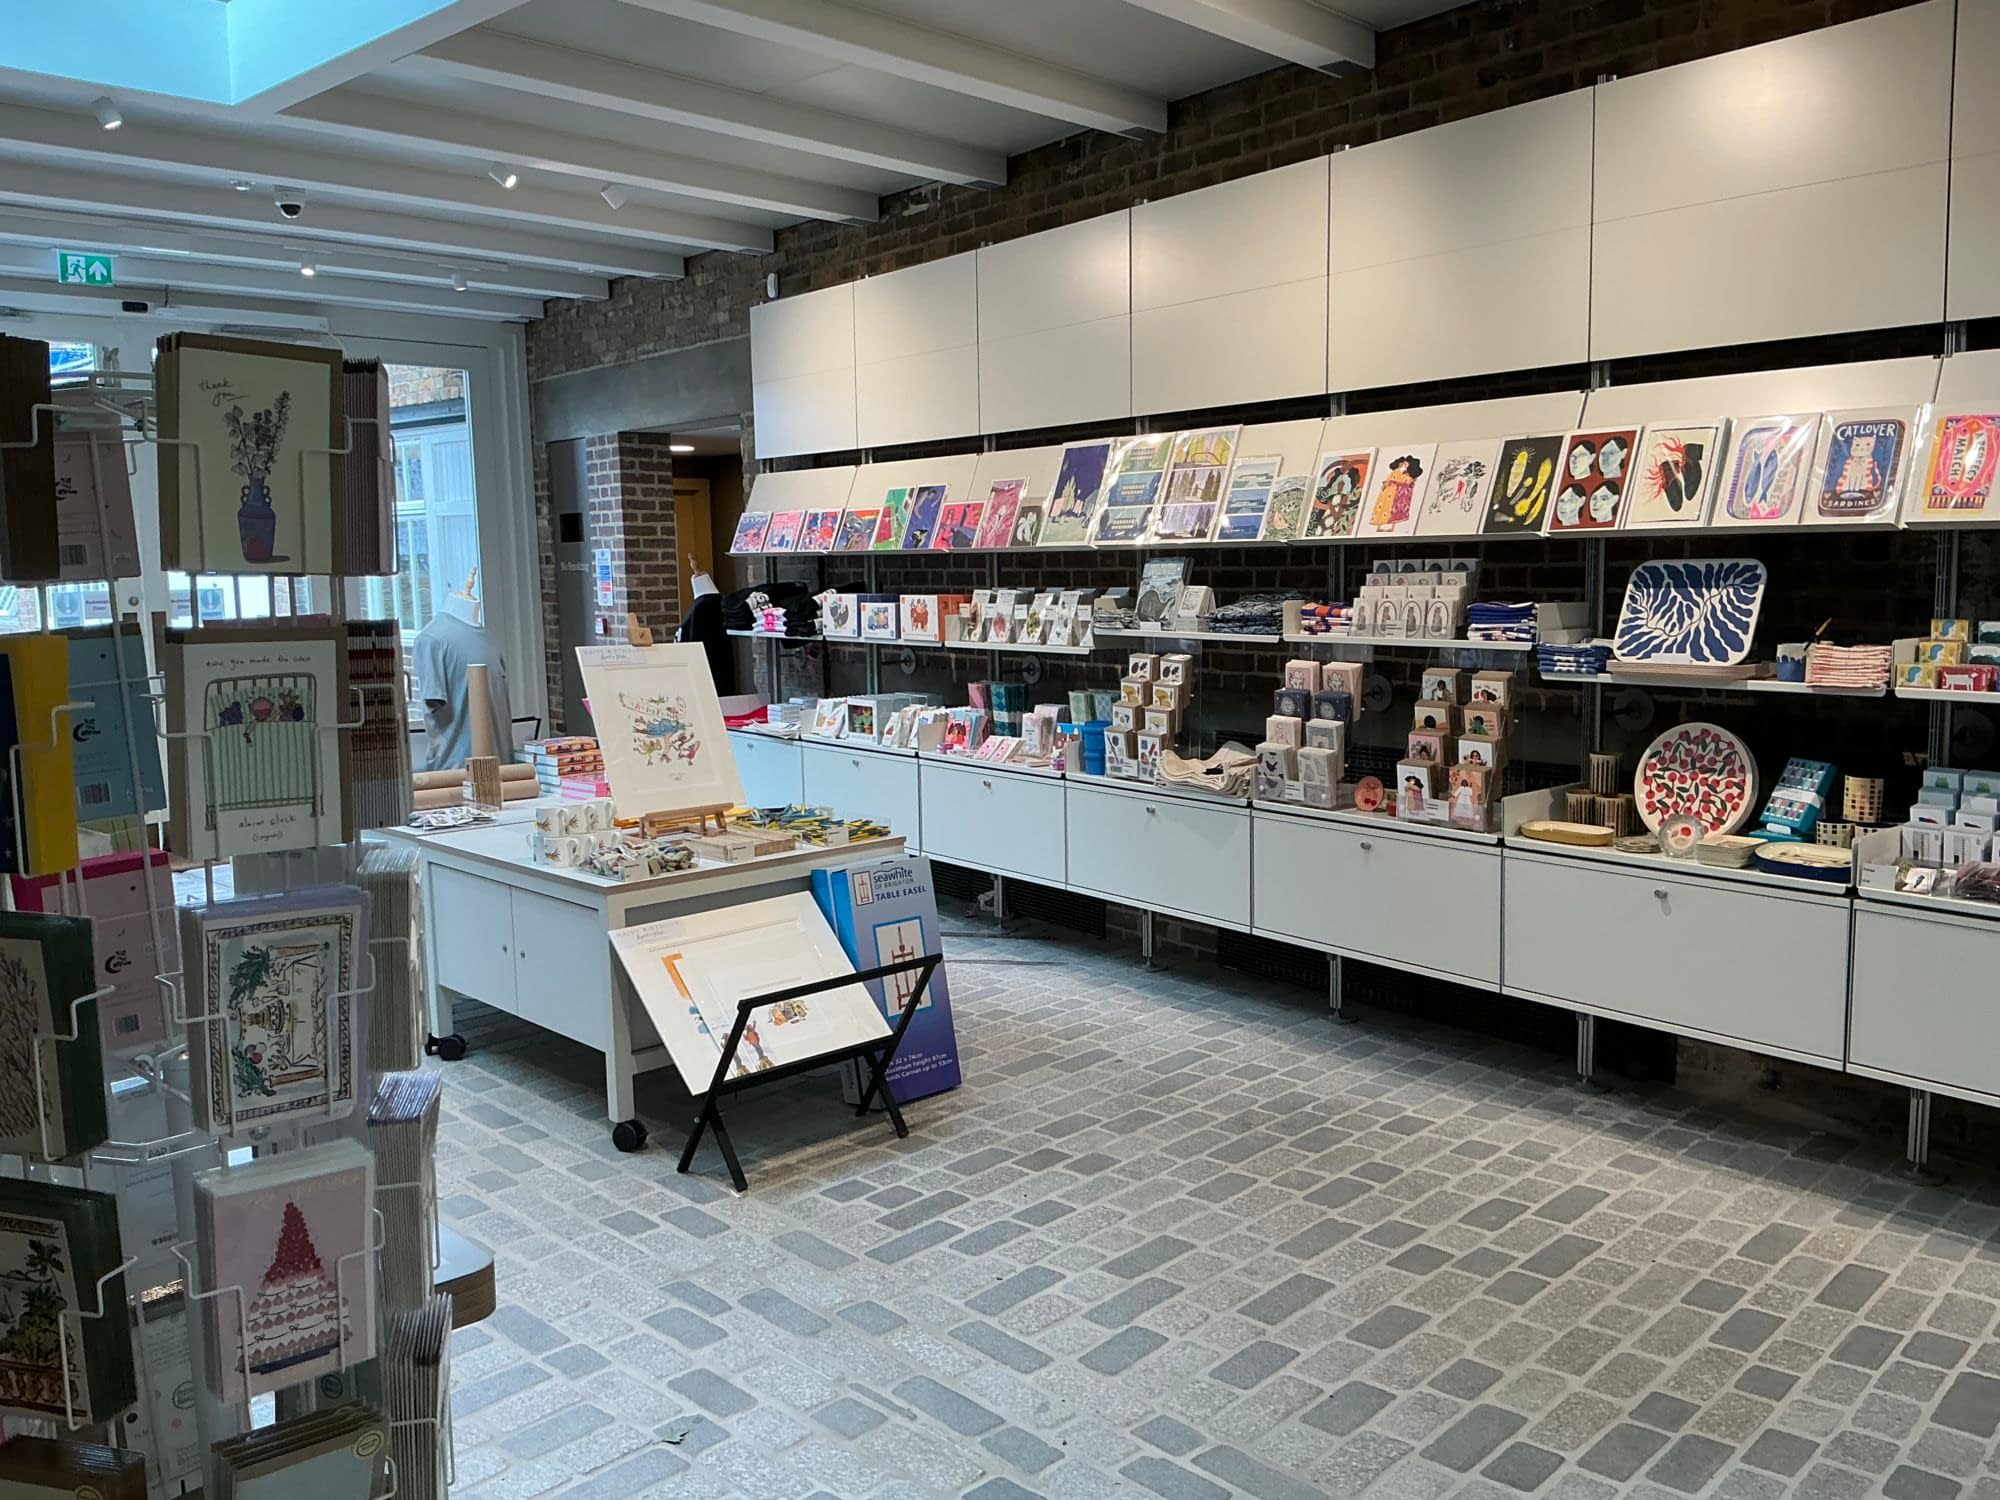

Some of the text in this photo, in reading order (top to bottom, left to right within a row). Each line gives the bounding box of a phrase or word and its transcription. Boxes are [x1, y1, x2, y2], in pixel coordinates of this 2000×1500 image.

[1836, 423, 1896, 441] CAT LOVER
[1949, 438, 1967, 476] MATCH
[1826, 499, 1876, 508] SARDINES
[238, 812, 297, 828] alarm clock
[872, 868, 913, 884] seawhite
[884, 878, 915, 888] BRIGHTON
[875, 885, 927, 901] TABLE EASEL
[912, 1056, 931, 1067] height
[922, 1065, 931, 1073] up
